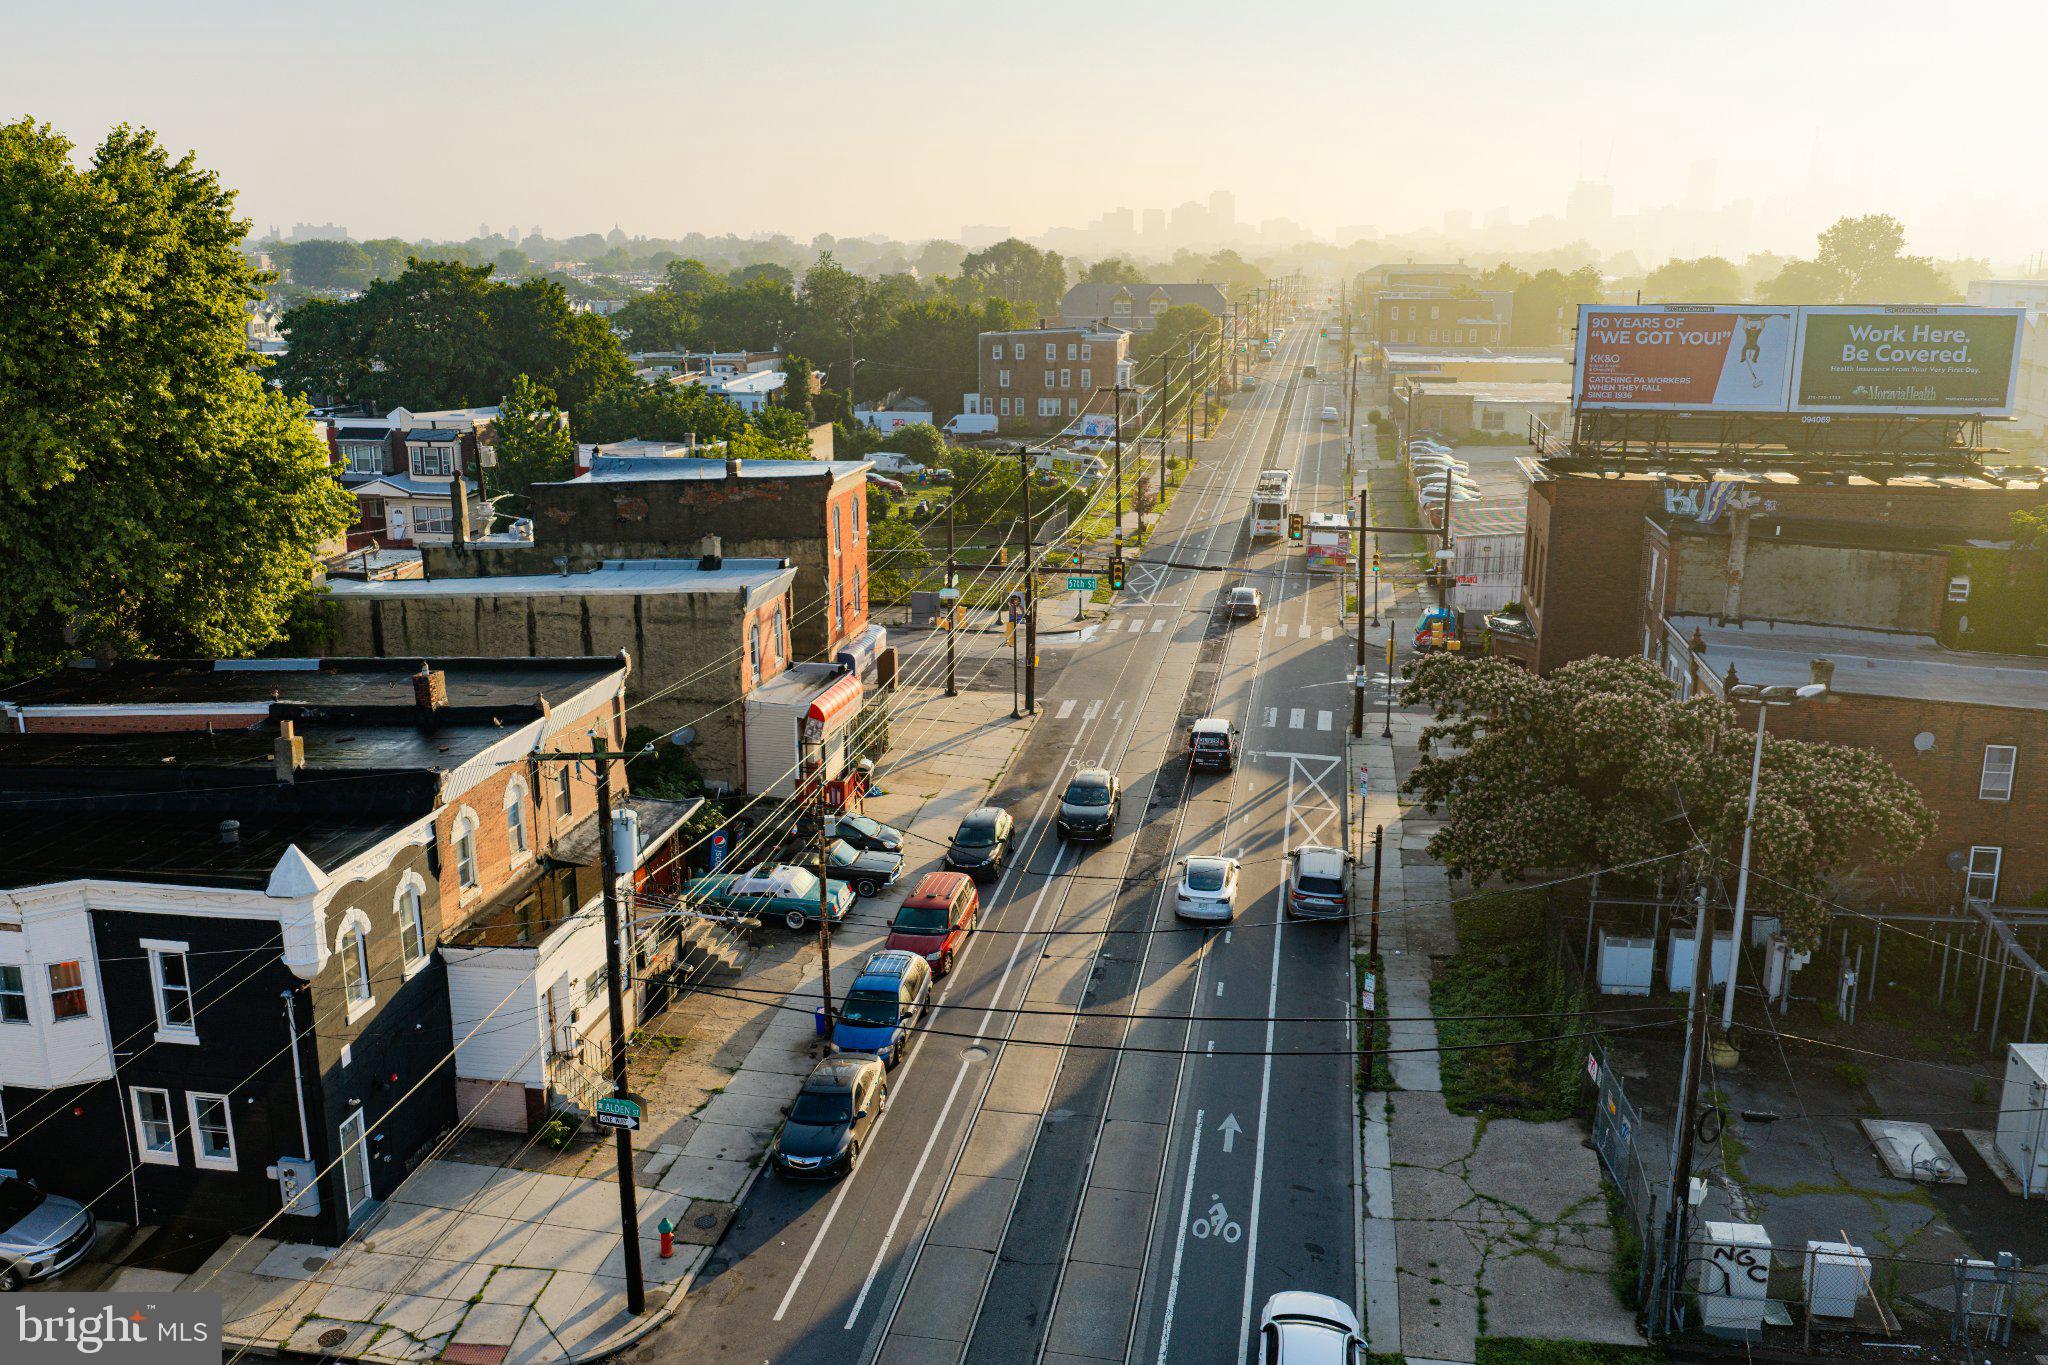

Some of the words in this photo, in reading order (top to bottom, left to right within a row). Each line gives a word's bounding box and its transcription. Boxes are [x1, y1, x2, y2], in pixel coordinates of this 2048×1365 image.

[1592, 317, 1610, 329] 90
[1613, 317, 1660, 329] YEARS
[1664, 317, 1685, 329] OF
[1635, 330, 1674, 345] GOT
[1848, 325, 1905, 343] Work
[1912, 325, 1971, 343] Here.
[1842, 344, 1869, 362] Be
[1875, 344, 1973, 363] Covered.
[1590, 354, 1620, 363] KK&O
[1856, 365, 1890, 373] Insurance
[1892, 365, 1910, 373] From
[1912, 365, 1927, 373] Your
[1930, 366, 1946, 374] Very
[1589, 376, 1631, 384] CATCHING
[1633, 376, 1645, 384] PA
[1647, 376, 1691, 385] WORKERS
[1618, 384, 1639, 392] THEY
[1641, 384, 1662, 392] FALL
[1587, 391, 1613, 399] SINCE
[1801, 415, 1831, 424] 094069
[1068, 580, 1085, 588] 57th
[1087, 580, 1095, 589] St
[605, 1104, 630, 1115] ALDEN
[601, 1115, 613, 1123] ONE
[615, 1117, 628, 1125] WAY
